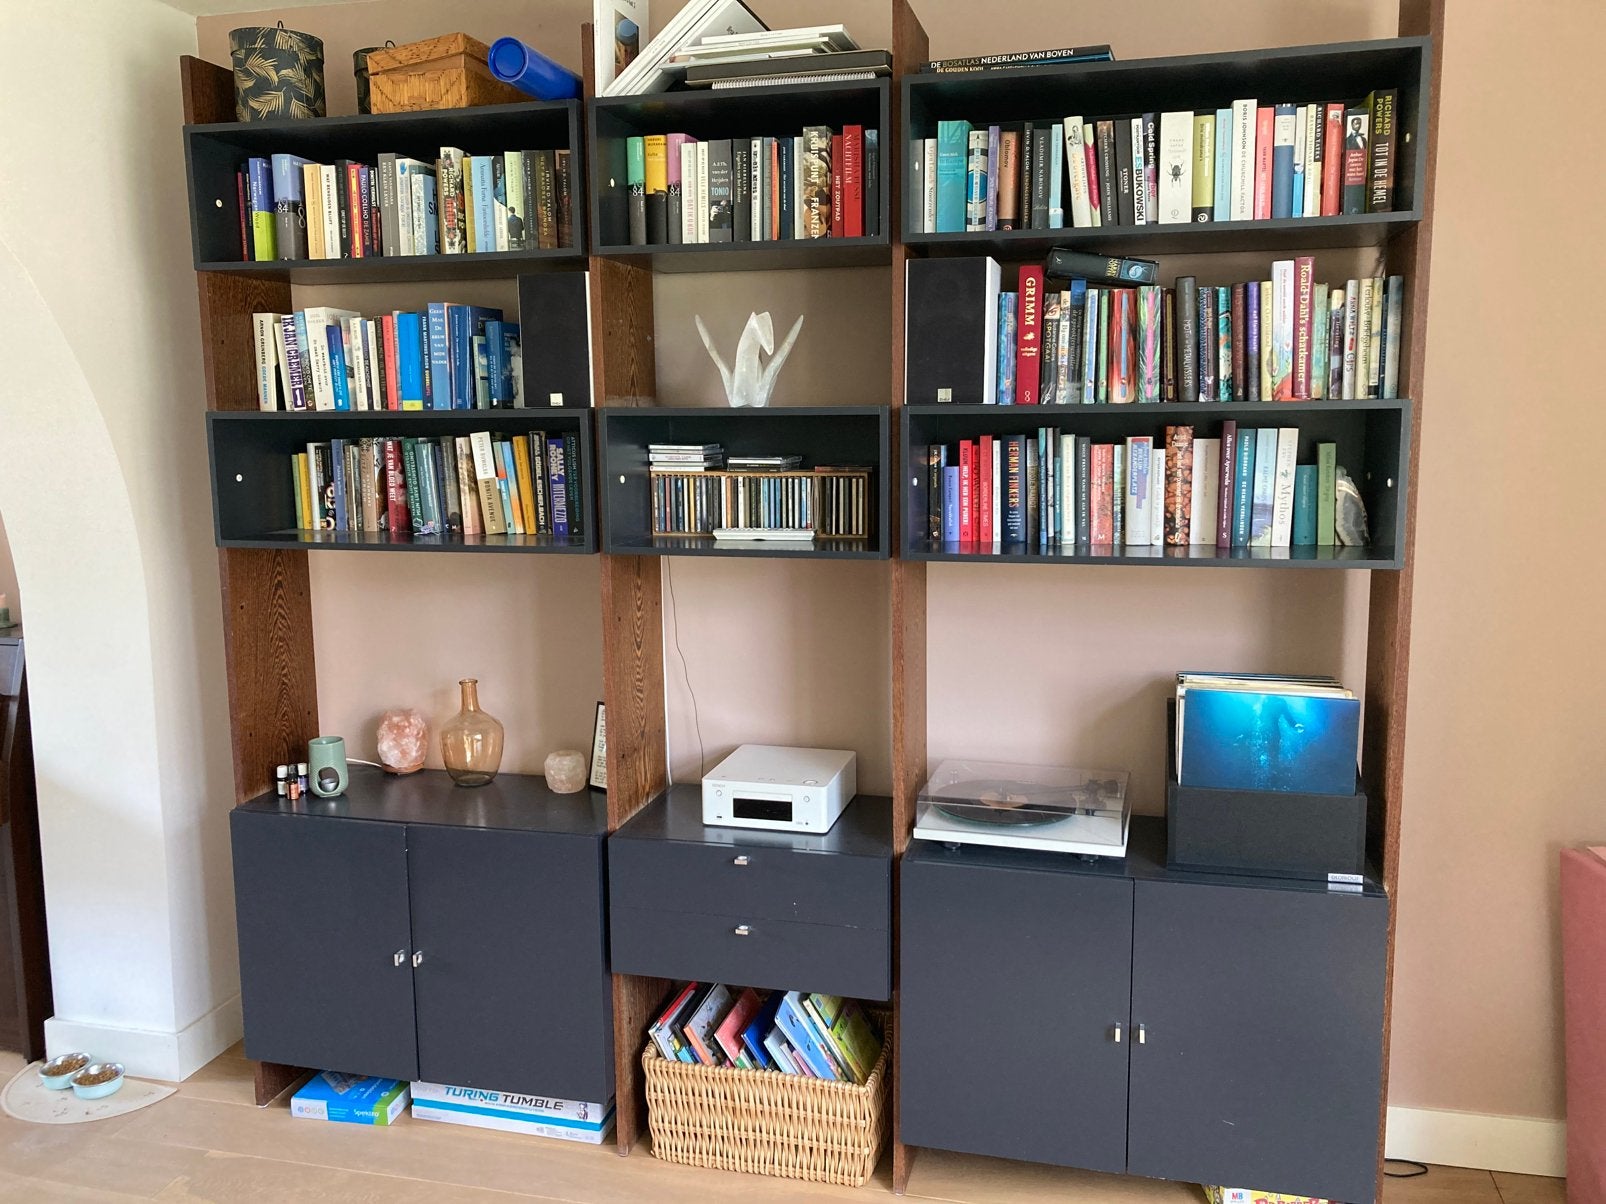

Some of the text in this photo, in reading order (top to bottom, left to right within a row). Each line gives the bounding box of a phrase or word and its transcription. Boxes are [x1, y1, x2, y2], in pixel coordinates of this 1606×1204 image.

[931, 61, 941, 69] DE
[942, 58, 981, 68] BOSATLAS
[981, 53, 1029, 64] NEDERLAND
[1030, 51, 1045, 60] VAN
[1046, 49, 1074, 58] BOVEN
[1315, 107, 1323, 137] RICHARD
[1375, 98, 1384, 135] POWERS
[1383, 95, 1392, 136] RICHARD
[1147, 122, 1156, 168] Cold Spring
[711, 187, 729, 196] TONIO
[810, 131, 820, 239] KRUISPUNT FRANZEN
[1372, 143, 1389, 205] TOT IN DE HEMEL
[1135, 168, 1144, 221] BUKOWSKI
[1024, 276, 1036, 326] GRIMM
[1183, 320, 1192, 334] MOT
[1298, 264, 1310, 382] Roald Dahl's schatkamer
[282, 316, 303, 387] IK JAN CREMER
[1360, 320, 1370, 364] Briefgeheim
[549, 444, 558, 481] ROONEY
[556, 447, 565, 476] SALLY
[1008, 441, 1019, 473] HERMAN
[552, 483, 567, 523] INTERMEZZO
[1008, 475, 1019, 508] FINKERS
[1278, 483, 1290, 526] Mythos
[488, 501, 496, 522] AVENUE
[444, 1086, 500, 1102] TURING
[502, 1093, 564, 1111] TUMBLE
[1231, 1192, 1243, 1200] MB
